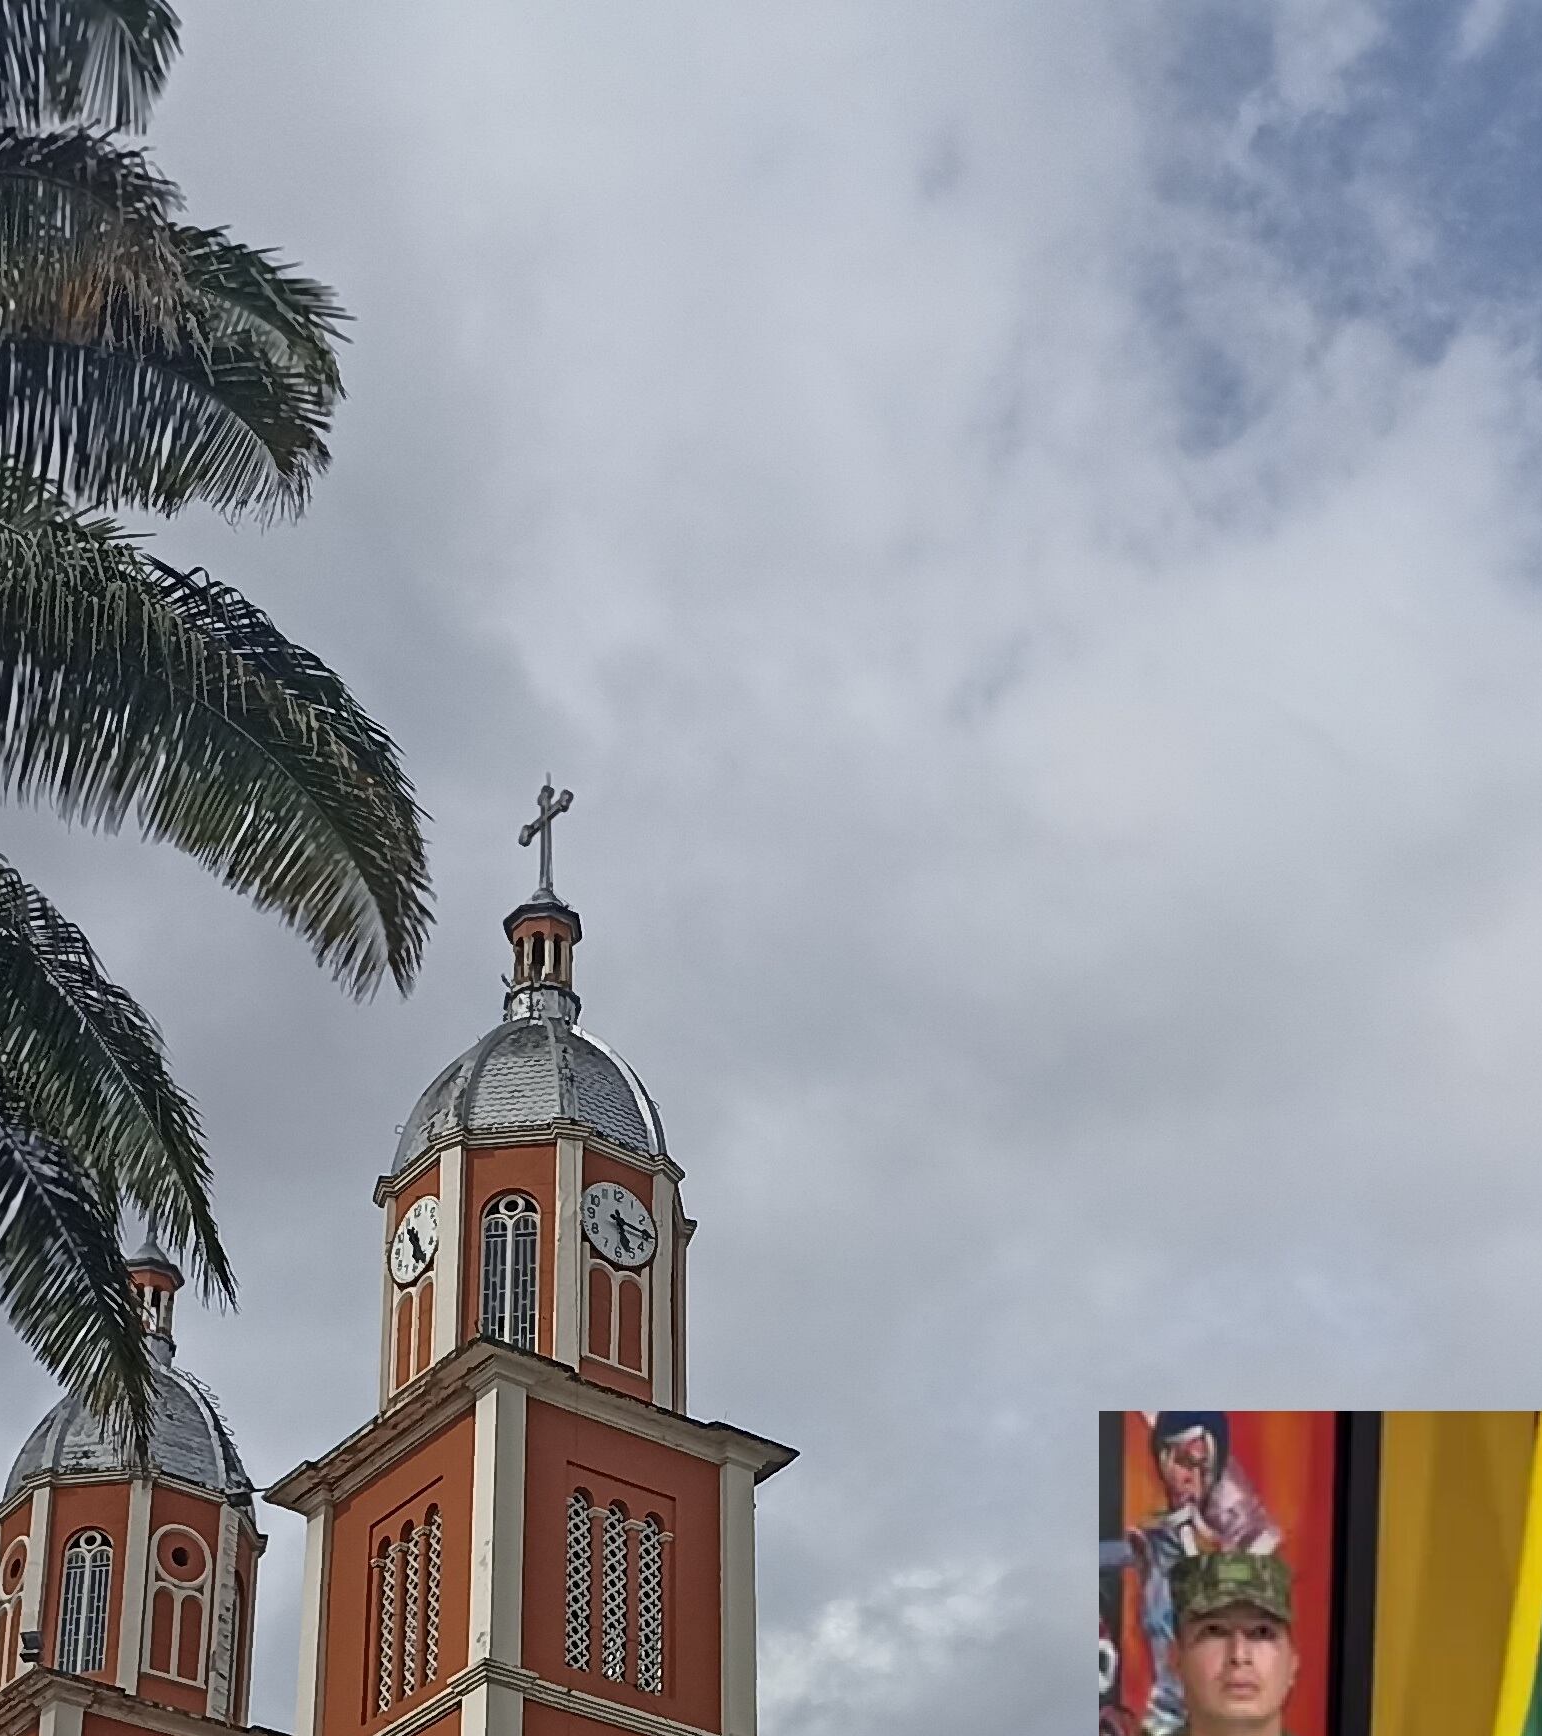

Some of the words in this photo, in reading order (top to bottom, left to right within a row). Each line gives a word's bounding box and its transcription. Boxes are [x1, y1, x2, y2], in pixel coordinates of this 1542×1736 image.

[590, 1194, 601, 1208] 10
[587, 1207, 596, 1219] 9
[591, 1222, 600, 1235] 8
